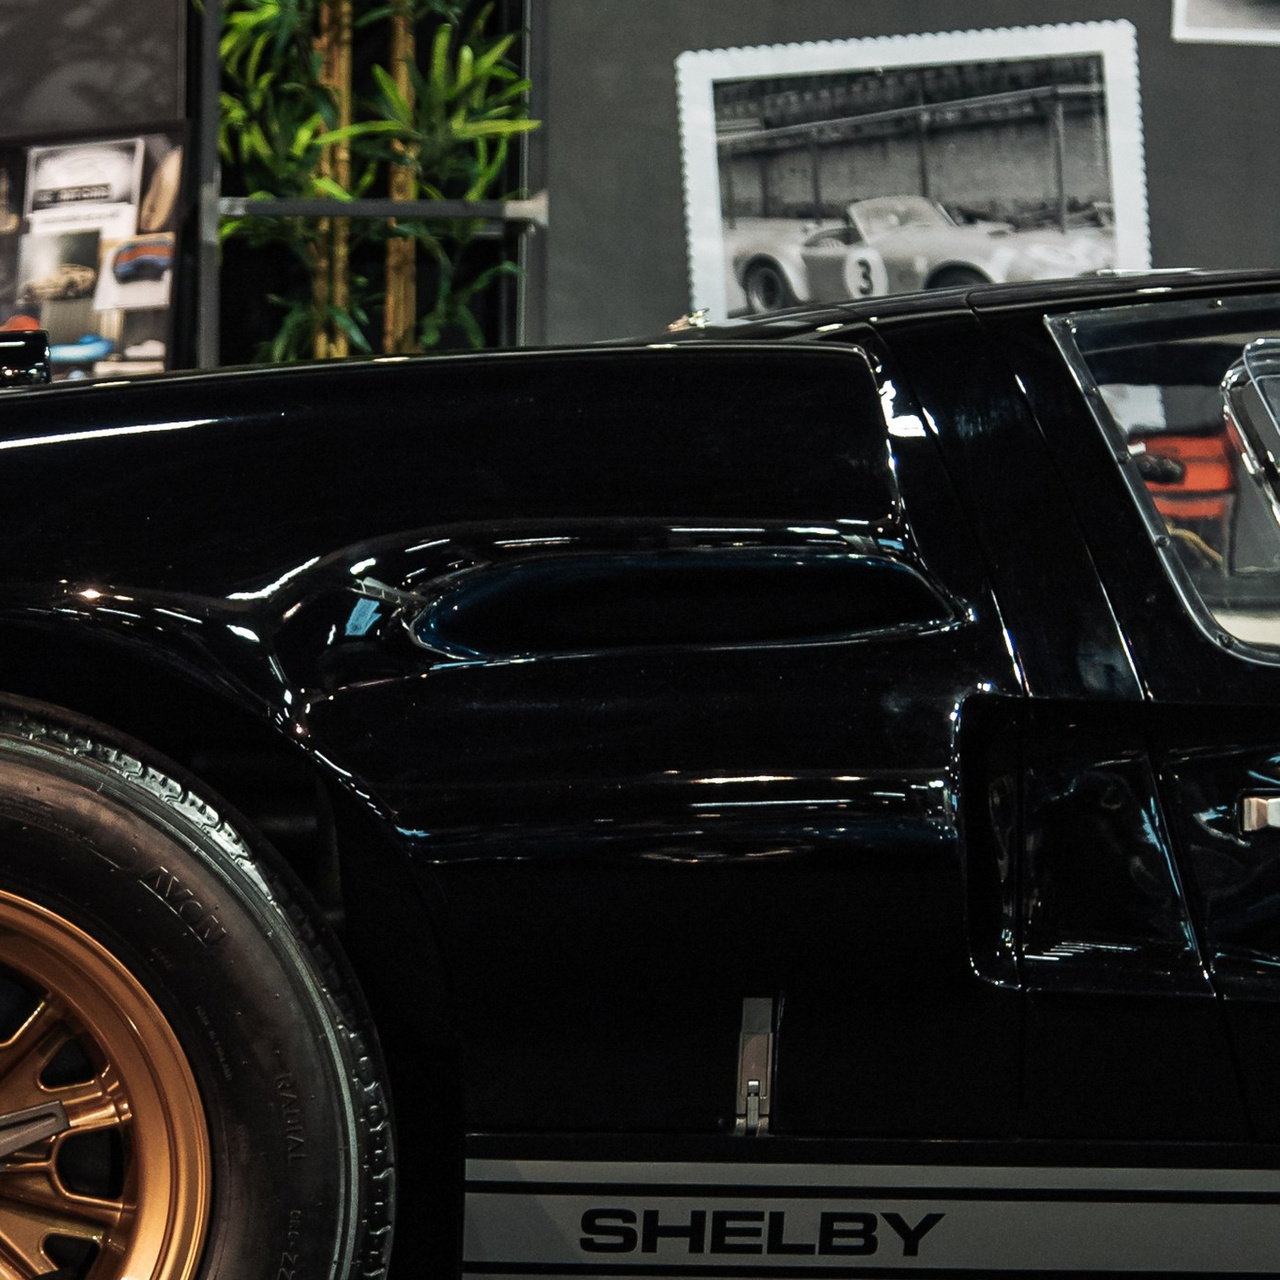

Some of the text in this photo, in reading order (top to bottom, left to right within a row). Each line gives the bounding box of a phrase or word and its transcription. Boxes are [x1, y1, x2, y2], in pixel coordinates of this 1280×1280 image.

[853, 257, 874, 296] 3
[141, 865, 227, 946] AVON
[275, 1072, 306, 1164] RADIAL
[579, 1208, 946, 1258] SHELBY
